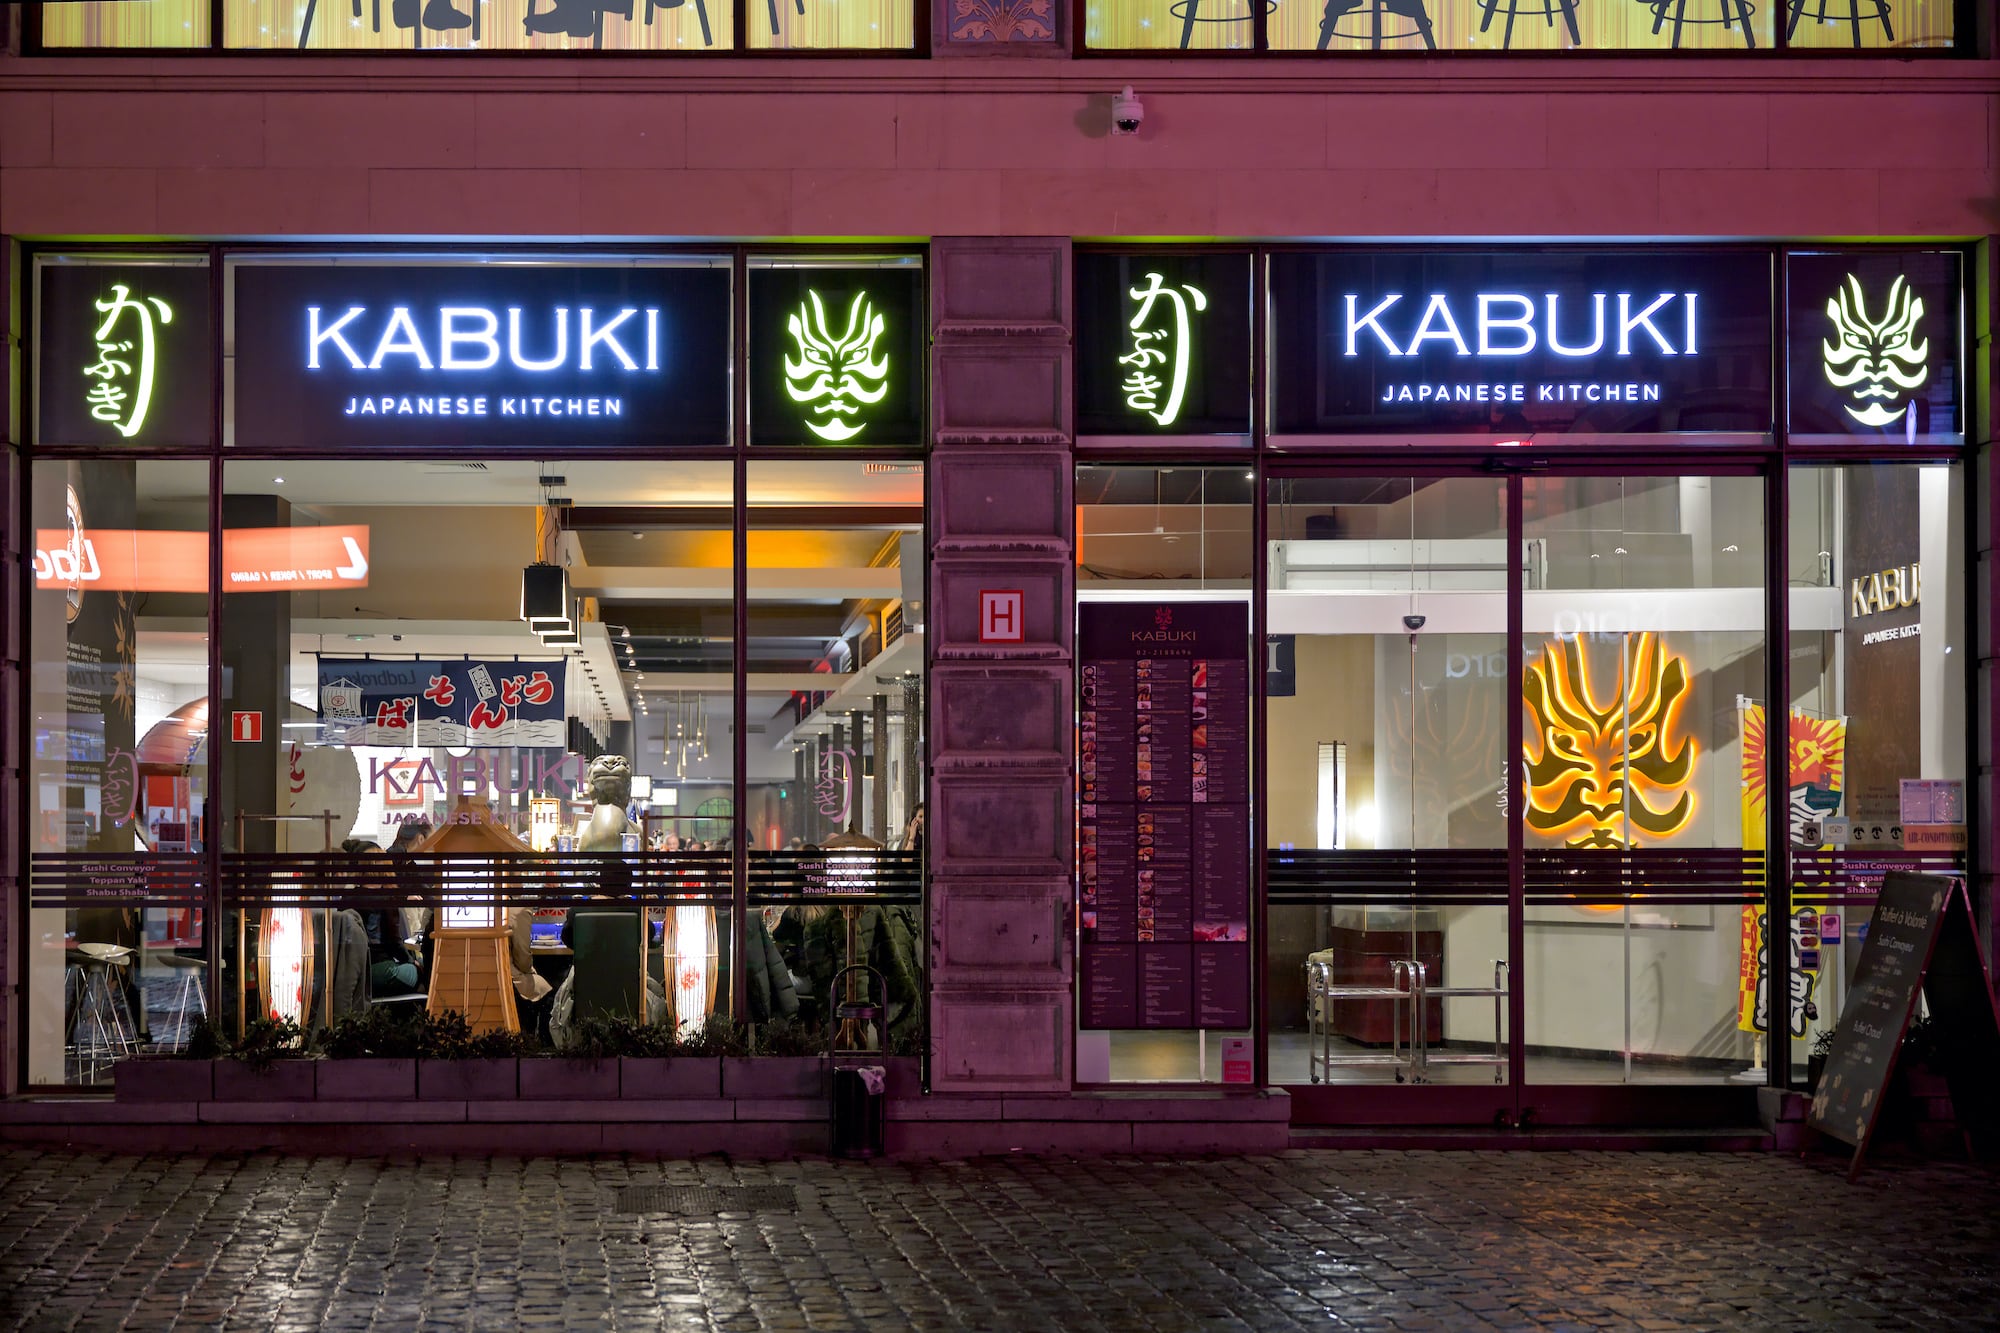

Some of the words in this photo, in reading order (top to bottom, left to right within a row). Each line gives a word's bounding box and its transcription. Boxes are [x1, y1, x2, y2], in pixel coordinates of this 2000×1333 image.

[1344, 293, 1698, 357] KABUKI
[307, 306, 659, 372] KABUKI
[1119, 272, 1206, 426] かぶき
[84, 284, 172, 437] かぶき
[1382, 384, 1525, 402] JAPANESE
[1539, 384, 1659, 401] KITCHEN
[345, 397, 487, 415] JAPANESE
[502, 398, 621, 416] KITCHEN
[990, 599, 1013, 632] H
[1131, 631, 1196, 641] KABUKI
[1863, 628, 1899, 646] JAPANESE
[368, 754, 585, 795] KABUKI
[382, 811, 481, 825] JAPANESE
[489, 811, 574, 825] KITCHEN
[1908, 831, 1965, 844] AIR-CONDITIONED
[81, 864, 108, 872] Sushi
[110, 864, 156, 873] Conveyor
[797, 862, 824, 870] Sushi
[825, 862, 871, 872] Conveyor
[1842, 862, 1868, 870] Sushi
[1869, 862, 1916, 871] Conveyor
[89, 876, 125, 885] Teppan
[127, 876, 147, 884] Yaki
[805, 874, 841, 884] Teppan
[841, 874, 863, 882] Yaki
[1849, 874, 1885, 883] Teppan
[86, 888, 117, 896] Shabu
[119, 888, 150, 896] Shabu
[802, 886, 833, 894] Shabu
[834, 886, 865, 894] Shabu
[1846, 886, 1878, 894] Shabu
